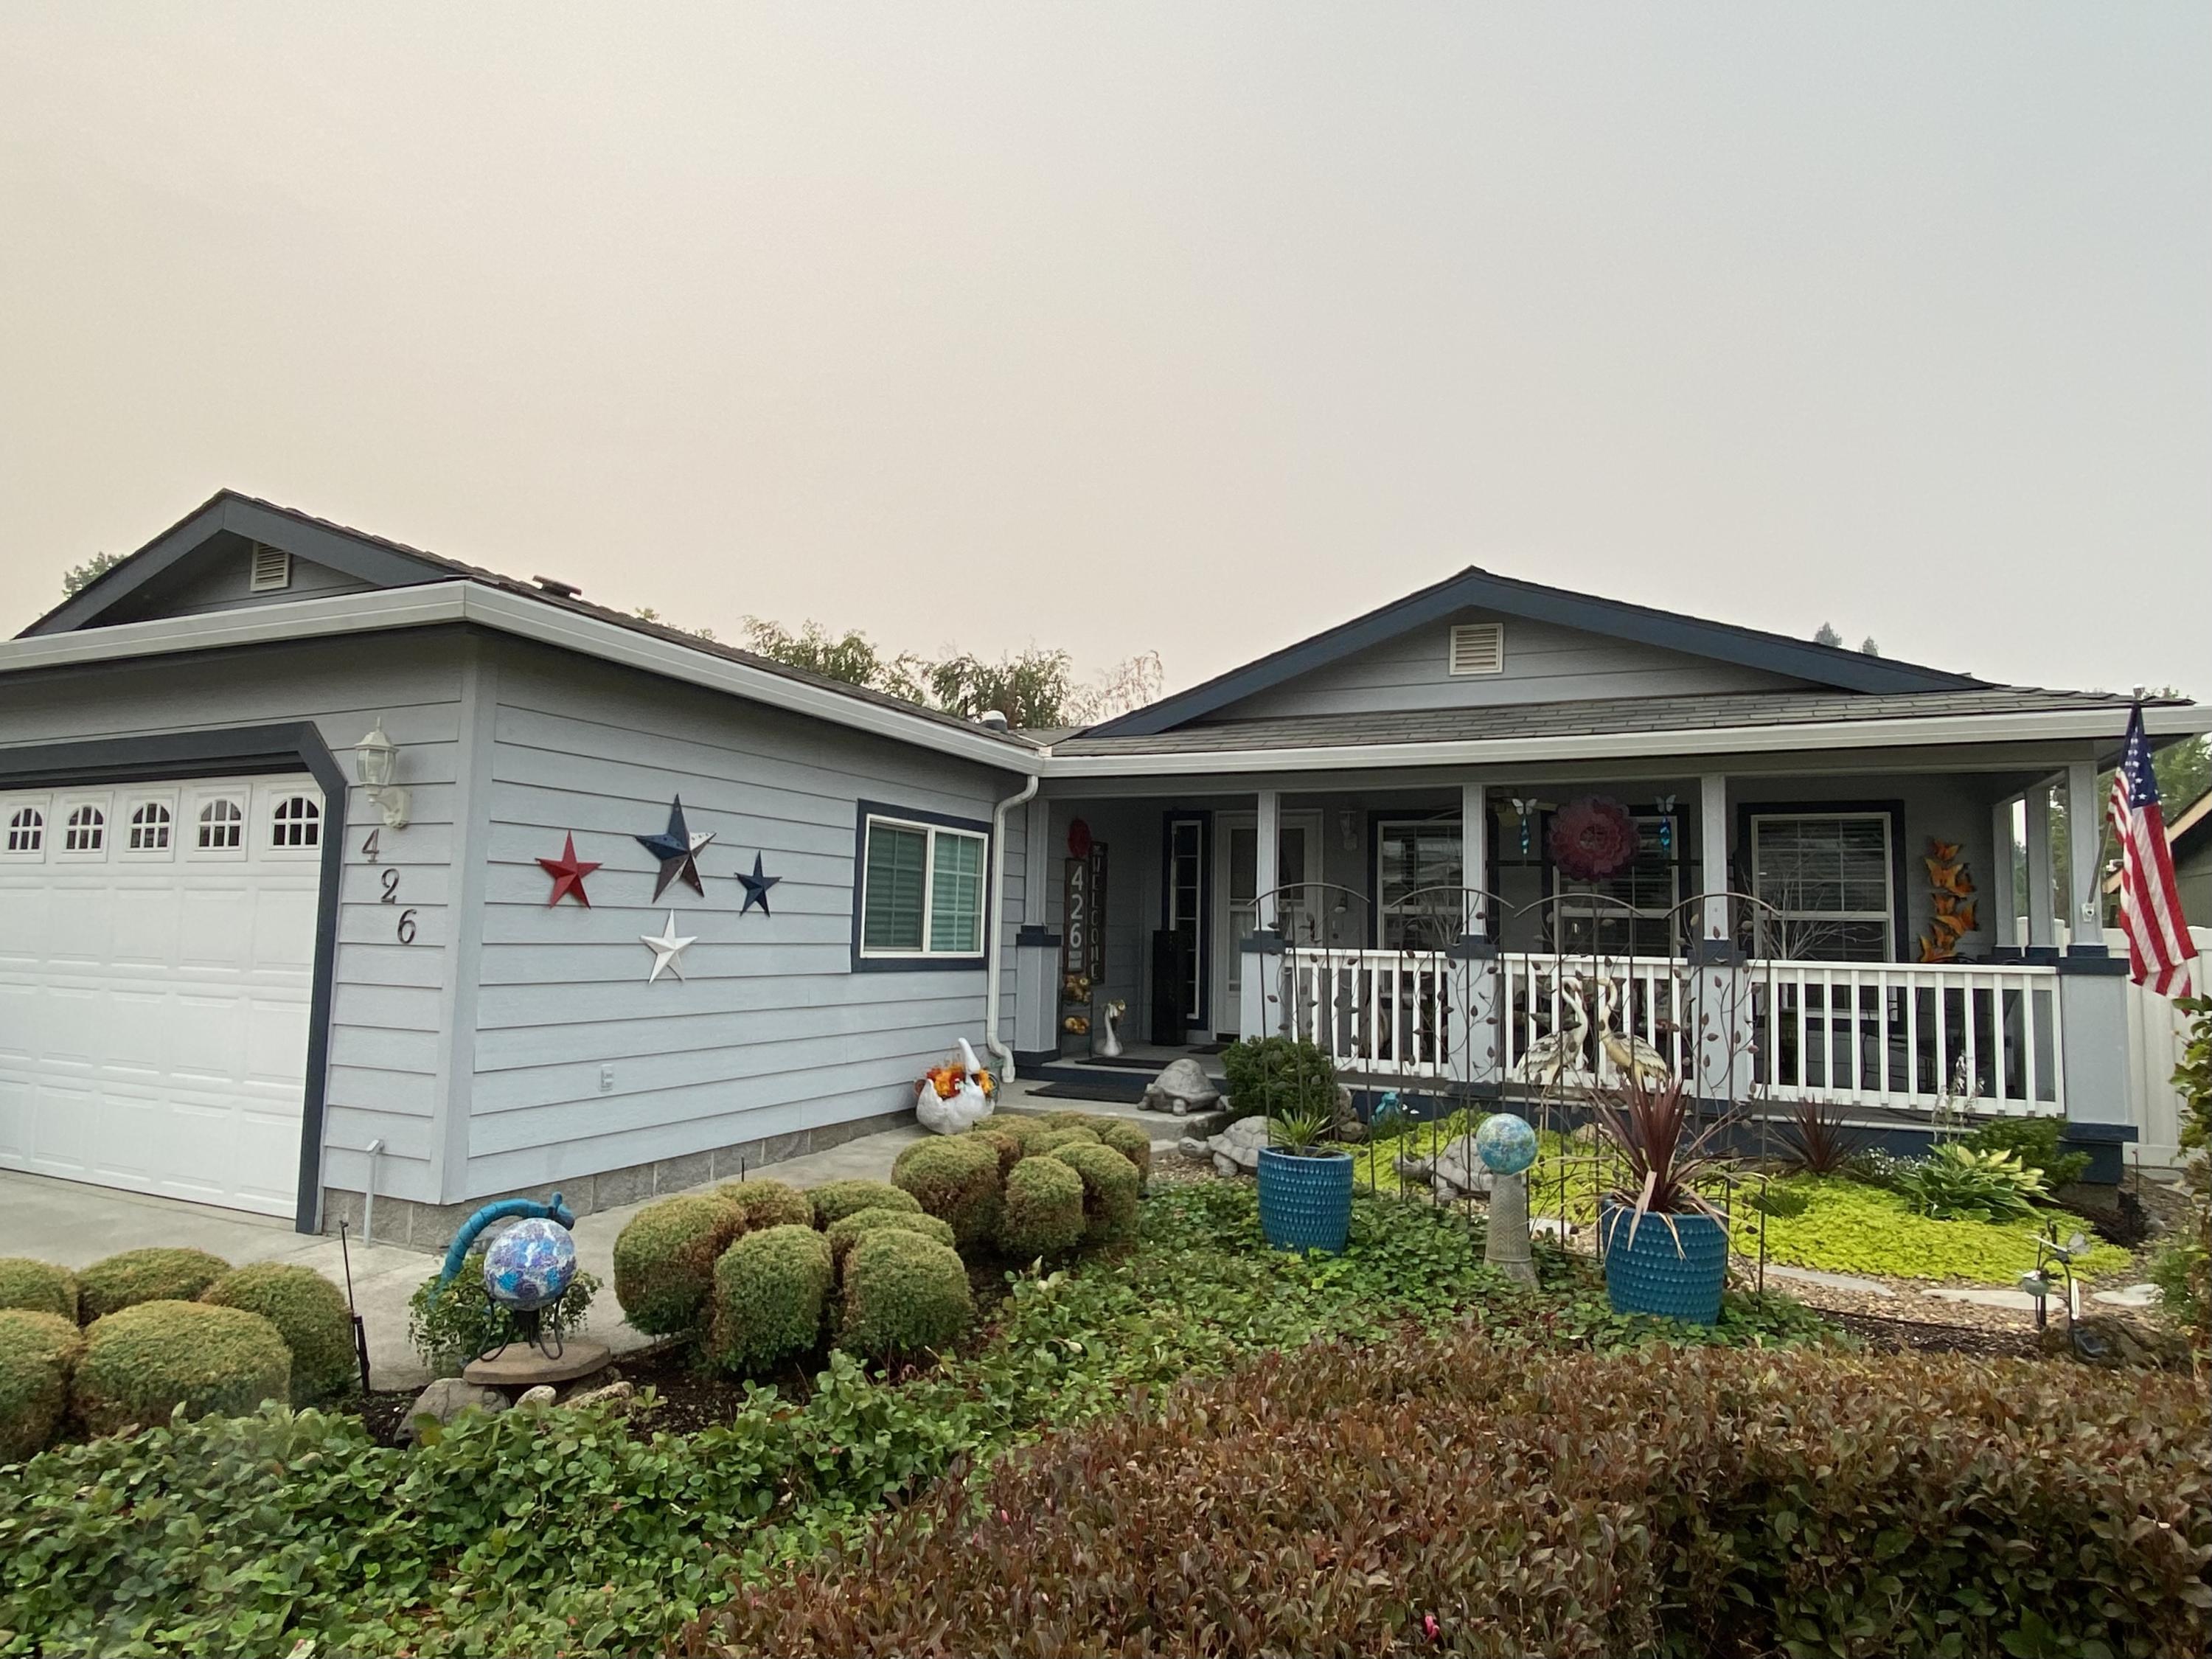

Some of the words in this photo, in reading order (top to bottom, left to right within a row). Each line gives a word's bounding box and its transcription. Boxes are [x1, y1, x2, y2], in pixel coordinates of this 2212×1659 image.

[361, 828, 417, 945] 426
[1070, 865, 1084, 949] 426
[1090, 856, 1102, 980] WELCOME
